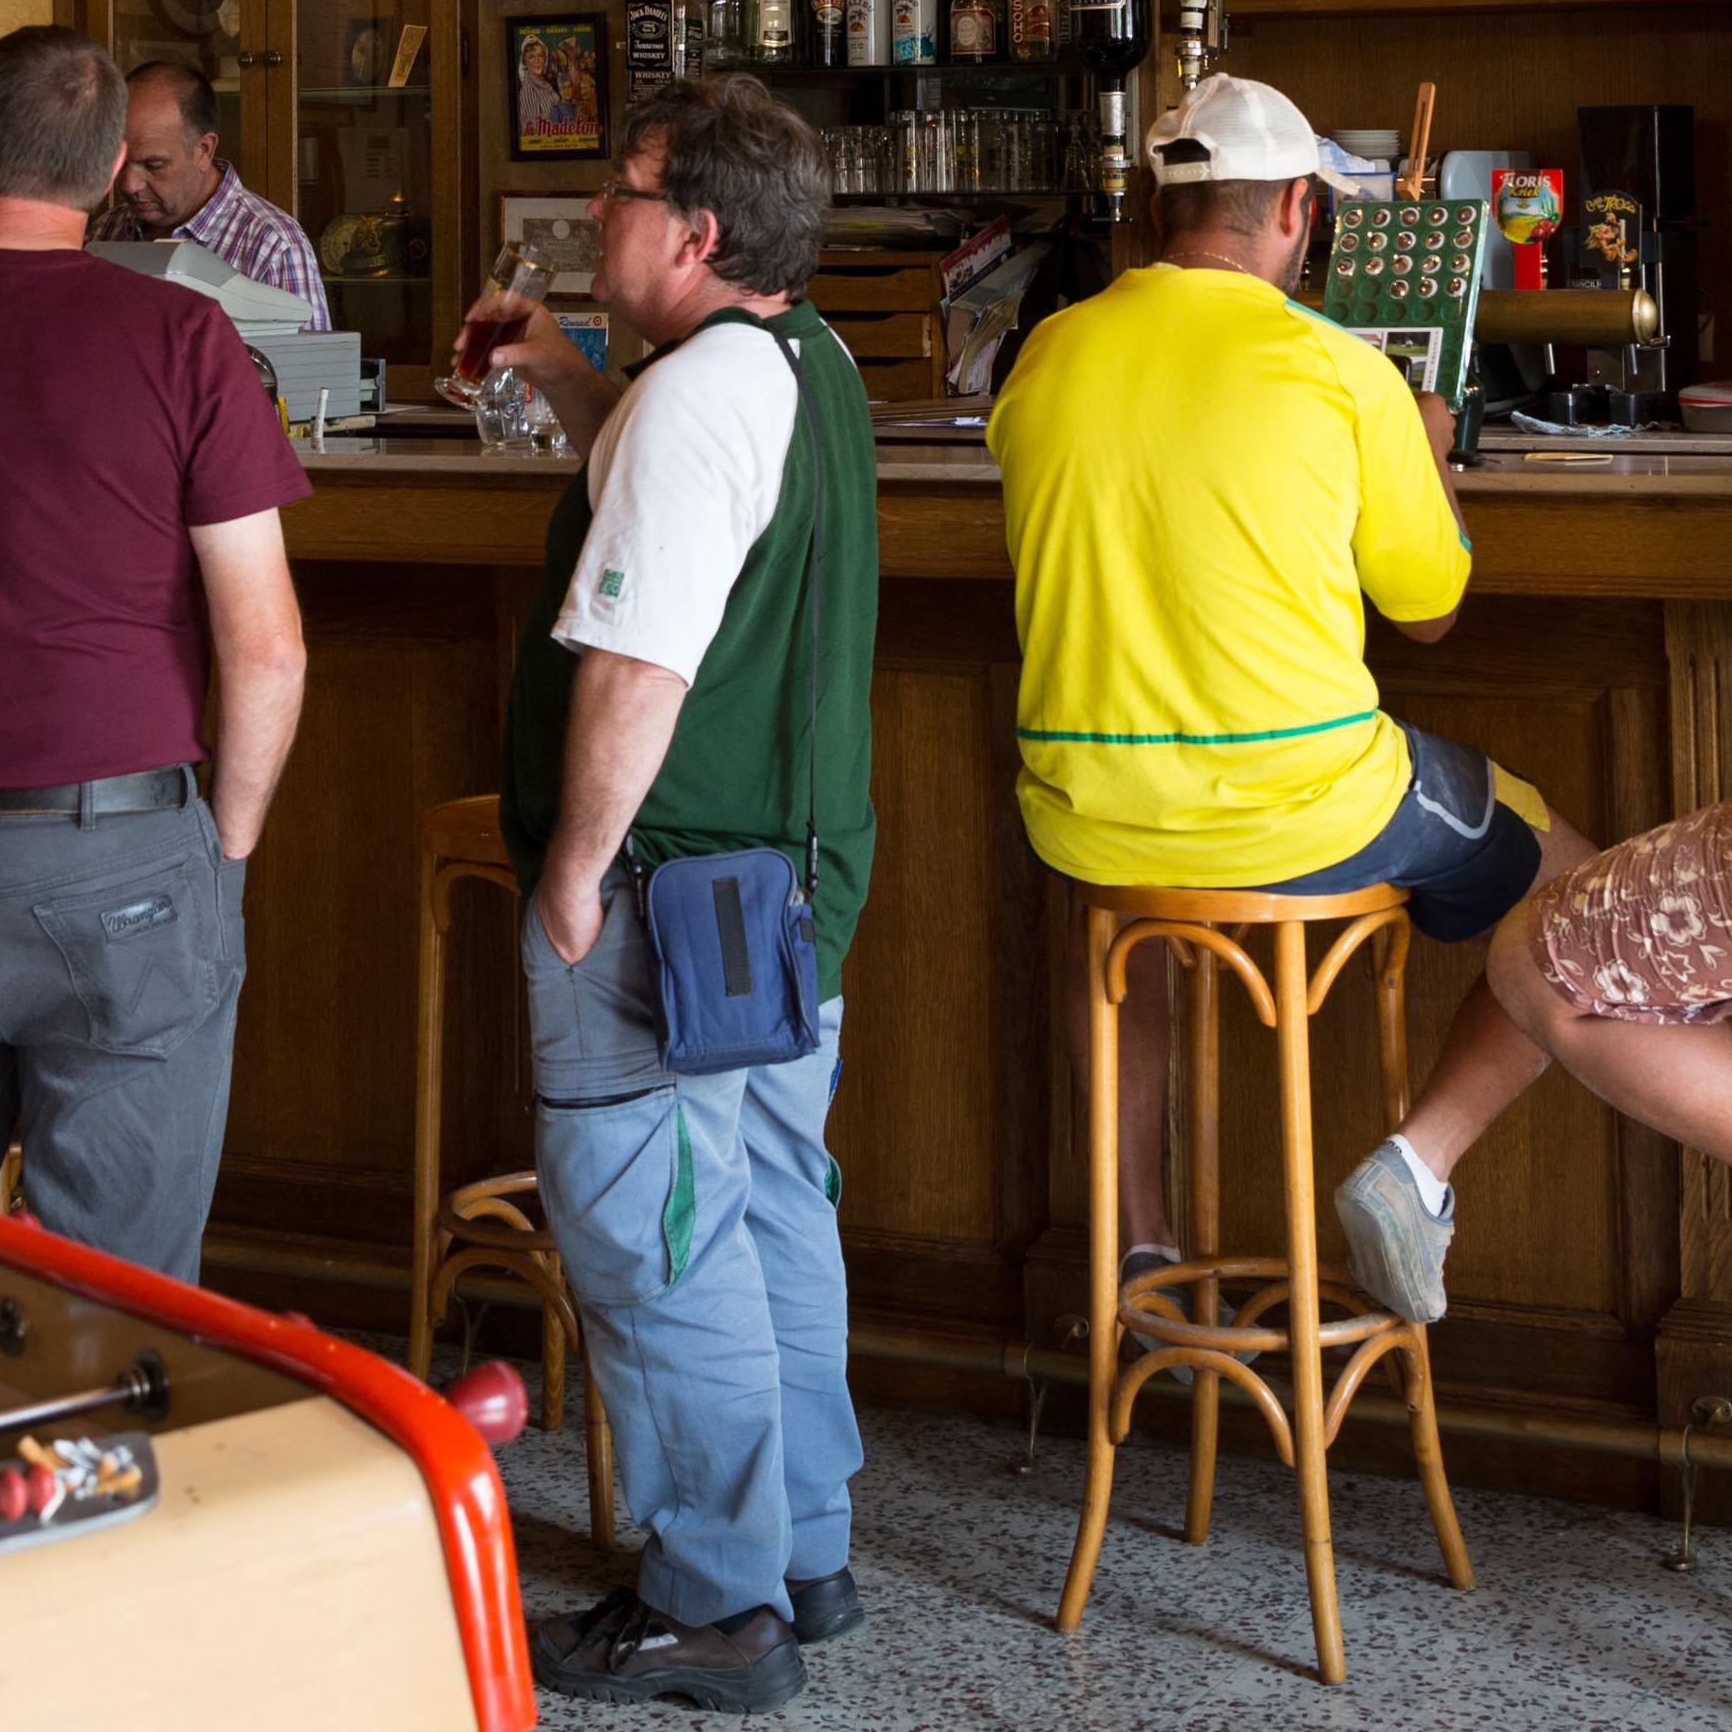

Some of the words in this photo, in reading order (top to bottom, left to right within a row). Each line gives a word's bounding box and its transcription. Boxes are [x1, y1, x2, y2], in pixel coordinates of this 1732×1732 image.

[630, 9, 645, 22] JACK
[1013, 0, 1023, 43] SOHO
[632, 51, 666, 59] WHISKEY
[634, 71, 671, 79] WHISKEY
[1502, 174, 1551, 188] FLORIS
[1509, 186, 1540, 197] Kriek
